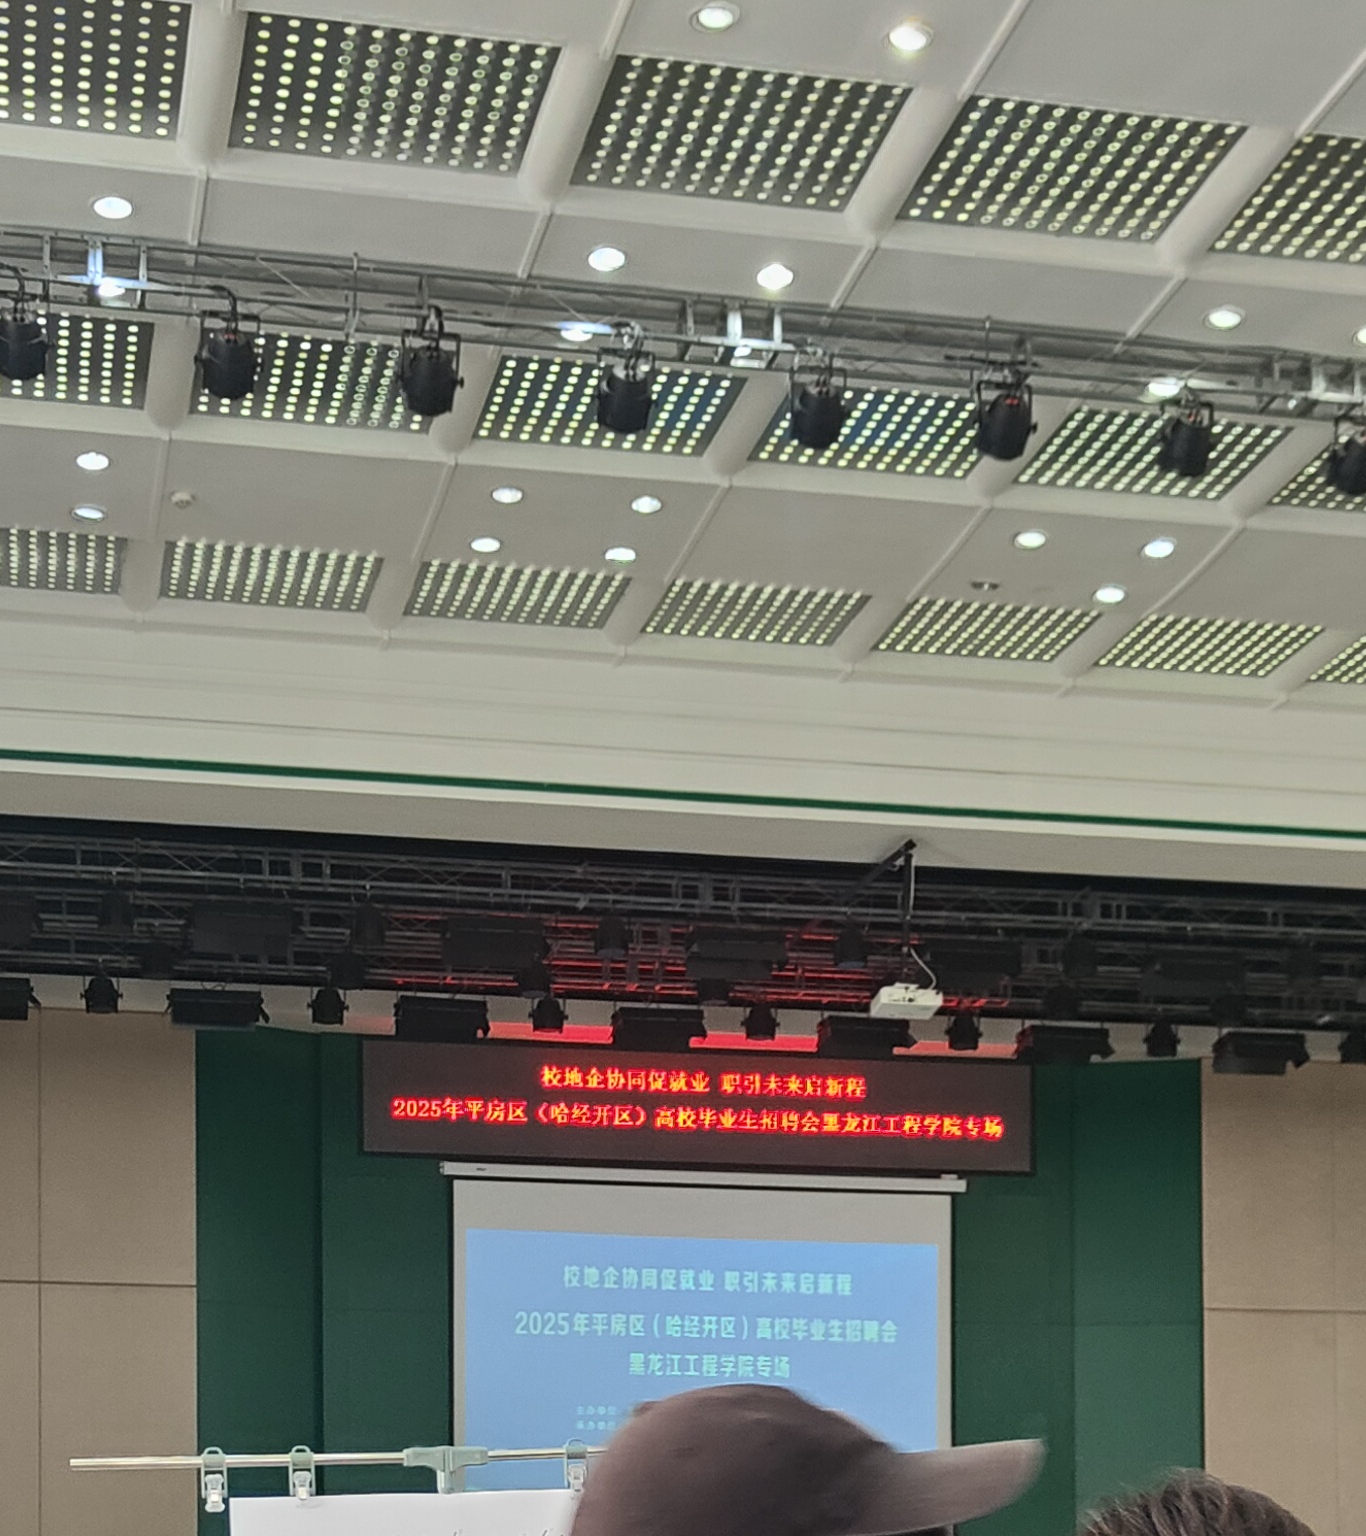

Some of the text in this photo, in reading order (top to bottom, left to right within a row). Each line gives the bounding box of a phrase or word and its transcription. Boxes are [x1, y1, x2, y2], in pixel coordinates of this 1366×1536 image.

[540, 1064, 867, 1099] 校地企协同促就业 职引未来启新程
[563, 1265, 853, 1296] 校地企协同促就业 职引未来启新程
[628, 1353, 791, 1379] 黑龙江工程学院专场
